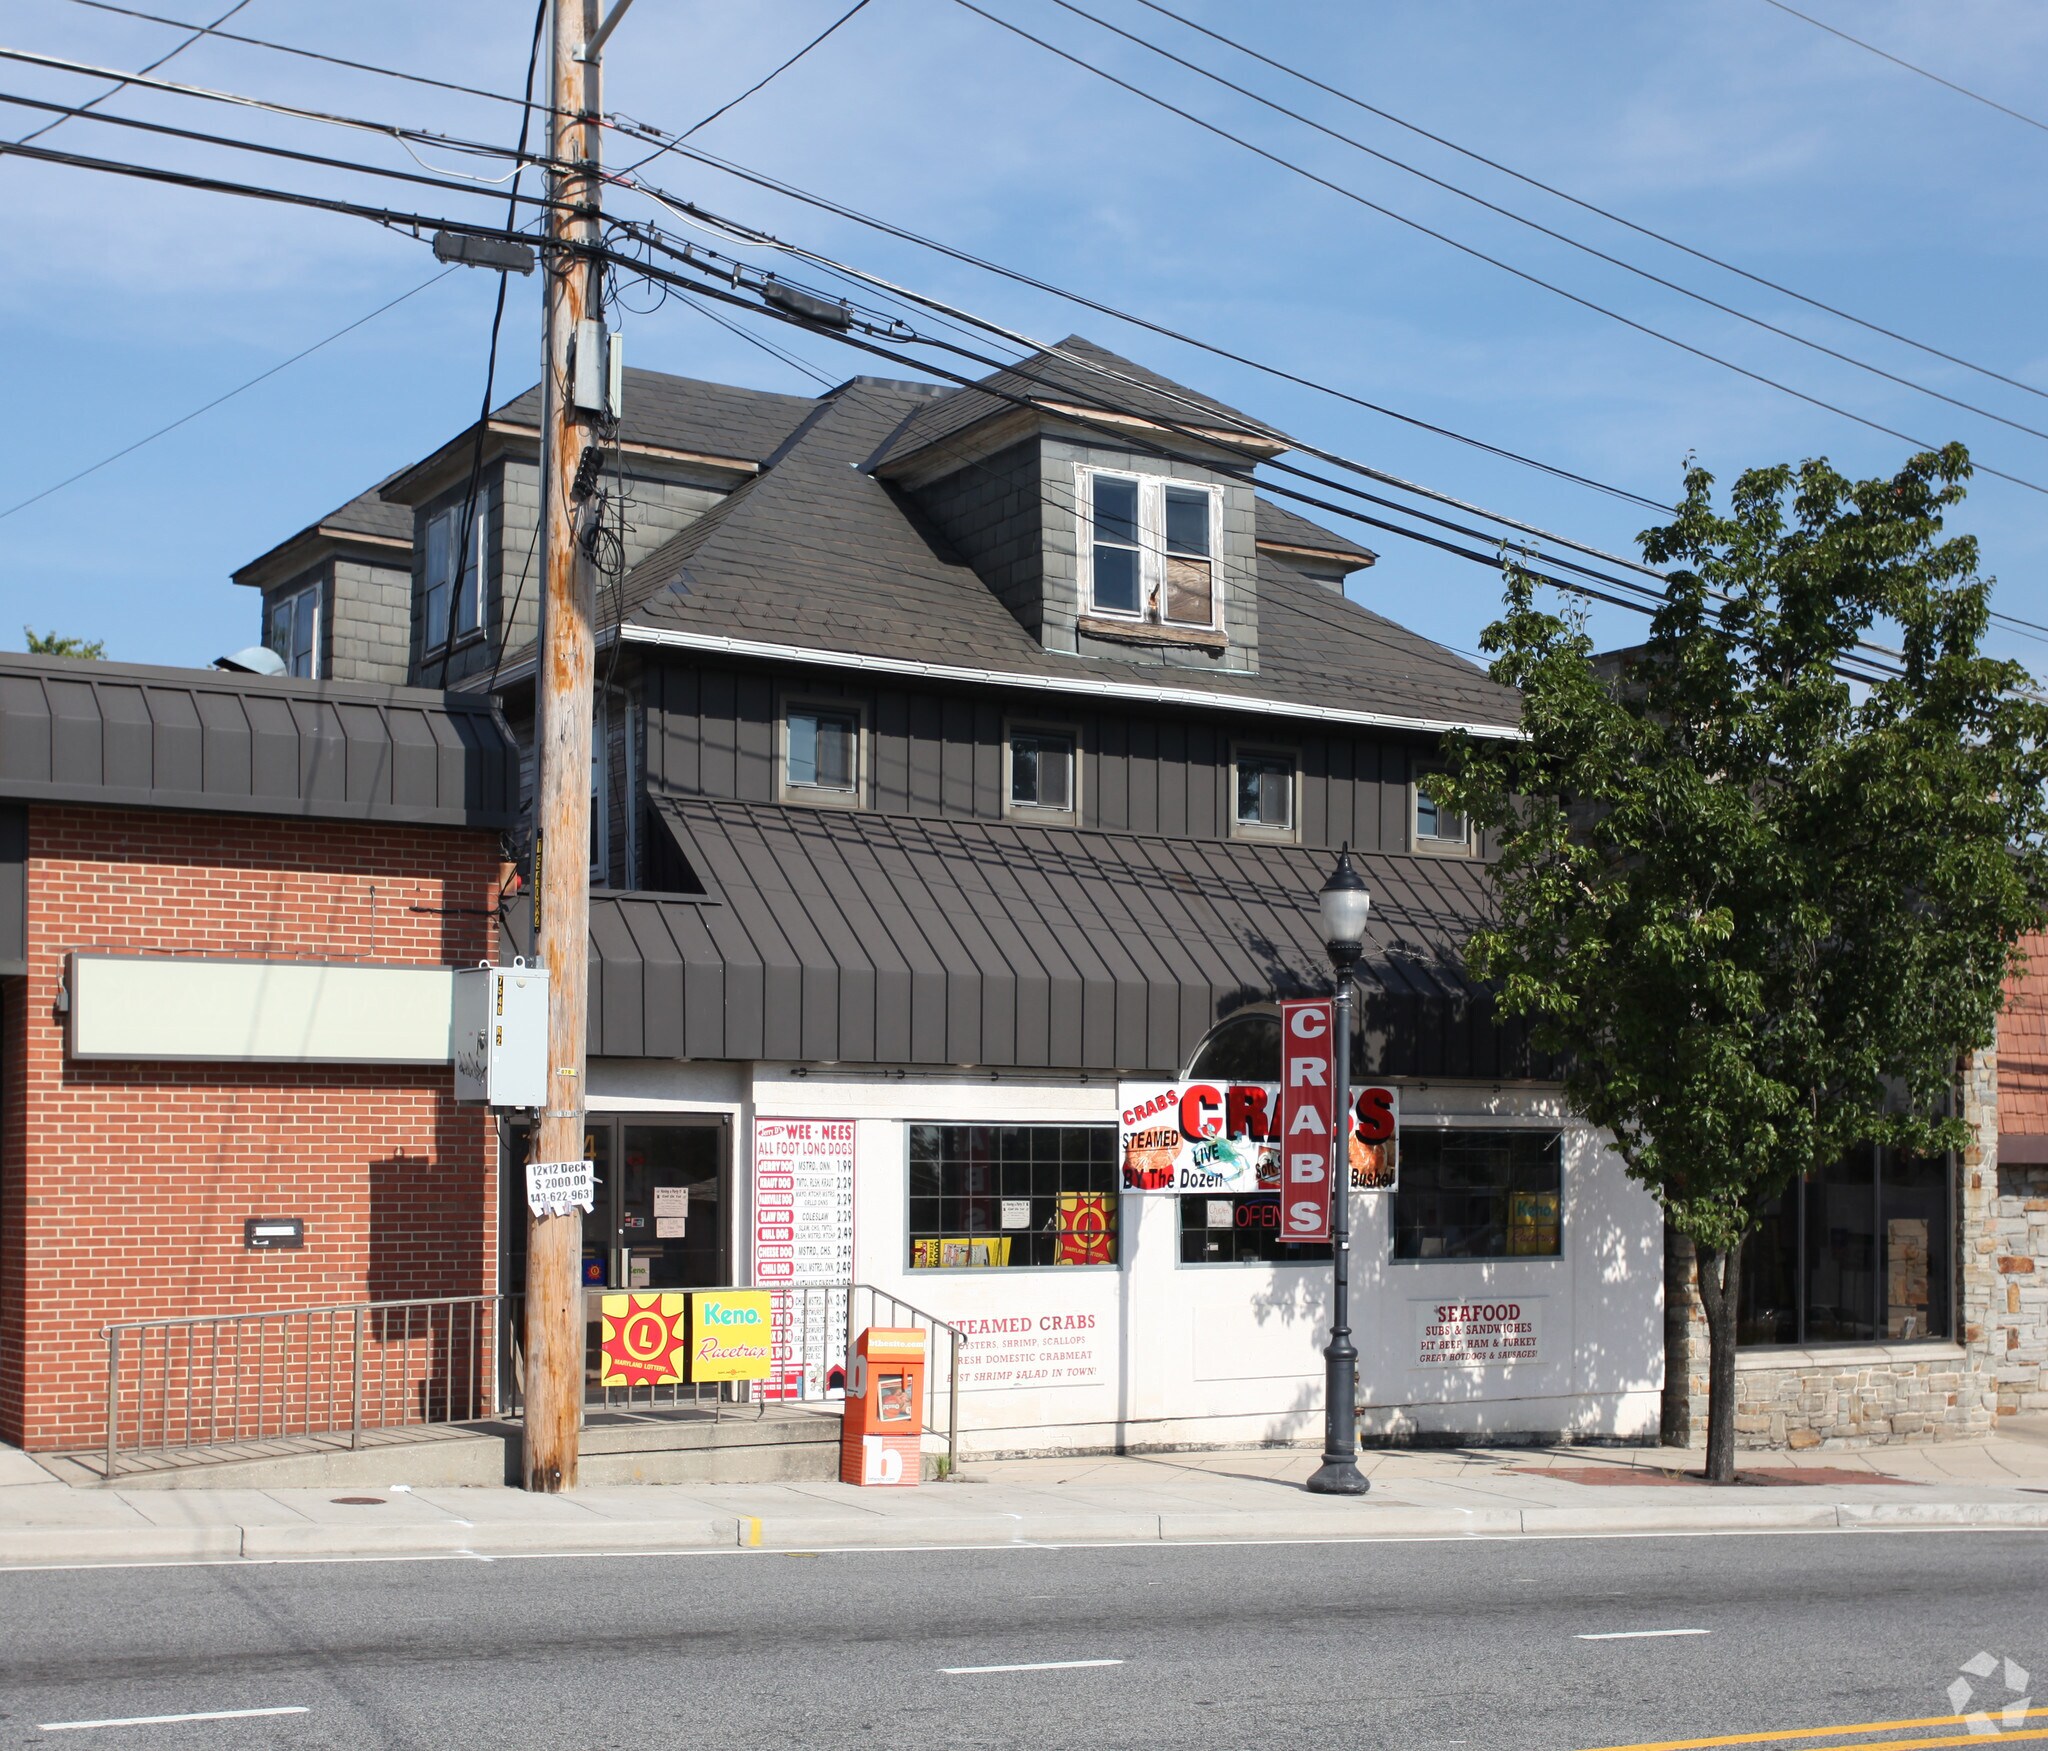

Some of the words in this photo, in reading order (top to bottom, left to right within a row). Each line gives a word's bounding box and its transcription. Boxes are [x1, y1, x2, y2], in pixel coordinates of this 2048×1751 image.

[1122, 1089, 1179, 1126] CRABS
[1178, 1084, 1395, 1146] CRS
[1288, 1007, 1328, 1233] CRABS
[786, 1124, 812, 1140] WEE
[821, 1124, 852, 1140] NEES
[1122, 1129, 1179, 1149] STEAMED
[758, 1141, 774, 1155] ALL
[776, 1141, 800, 1155] FOOT
[802, 1142, 826, 1155] LONG
[828, 1142, 853, 1156] DOGS
[1193, 1144, 1220, 1167] LIVE
[532, 1163, 559, 1176] 12x12
[560, 1162, 587, 1174] Deck
[836, 1160, 852, 1172] 1.99
[535, 1179, 542, 1190] $
[545, 1174, 587, 1189] 2000.00
[836, 1177, 852, 1189] 2.29
[1122, 1168, 1144, 1189] BY
[1150, 1168, 1175, 1189] The
[1180, 1168, 1223, 1188] Dozen
[1351, 1167, 1395, 1188] Bushel
[836, 1193, 852, 1206] 2.29
[776, 1211, 790, 1222] DOG
[802, 1212, 829, 1221] COLESLAW
[836, 1210, 852, 1222] 2.29
[776, 1228, 789, 1240] DOG
[836, 1227, 852, 1240] 2.49
[779, 1246, 793, 1258] DOG
[836, 1245, 852, 1258] 2.49
[777, 1263, 790, 1275] DOG
[836, 1261, 851, 1274] 2.49
[704, 1302, 761, 1325] Keno.
[1438, 1304, 1521, 1322] SEAFOOD
[947, 1317, 1032, 1336] STEAMED
[1039, 1314, 1096, 1331] CRABS
[1425, 1325, 1450, 1336] SUBS
[1454, 1325, 1462, 1335] &
[1466, 1322, 1532, 1335] SANDWICHES
[639, 1324, 653, 1349] L
[1042, 1336, 1086, 1346] SCALLOPS
[1421, 1341, 1436, 1350] PIT
[1467, 1339, 1489, 1349] HAM
[1492, 1339, 1499, 1347] &
[1503, 1337, 1537, 1347] TURKEY
[695, 1337, 768, 1362] Racetrax
[1420, 1354, 1447, 1362] GREAT
[1449, 1352, 1486, 1361] HOTDOGS
[1489, 1351, 1495, 1359] &
[1498, 1350, 1538, 1359] SAUSAGES!
[614, 1358, 643, 1369] MARYLAND
[957, 1355, 982, 1365] RESH
[986, 1353, 1036, 1364] DOMESTIC
[1039, 1350, 1093, 1361] CRABMEAT
[946, 1373, 971, 1383] BST
[973, 1371, 1013, 1381] SHRIMP
[1016, 1369, 1048, 1380] SALAD
[1051, 1368, 1063, 1377] IN
[1067, 1367, 1097, 1377] TOWN!
[862, 1434, 903, 1485] b
